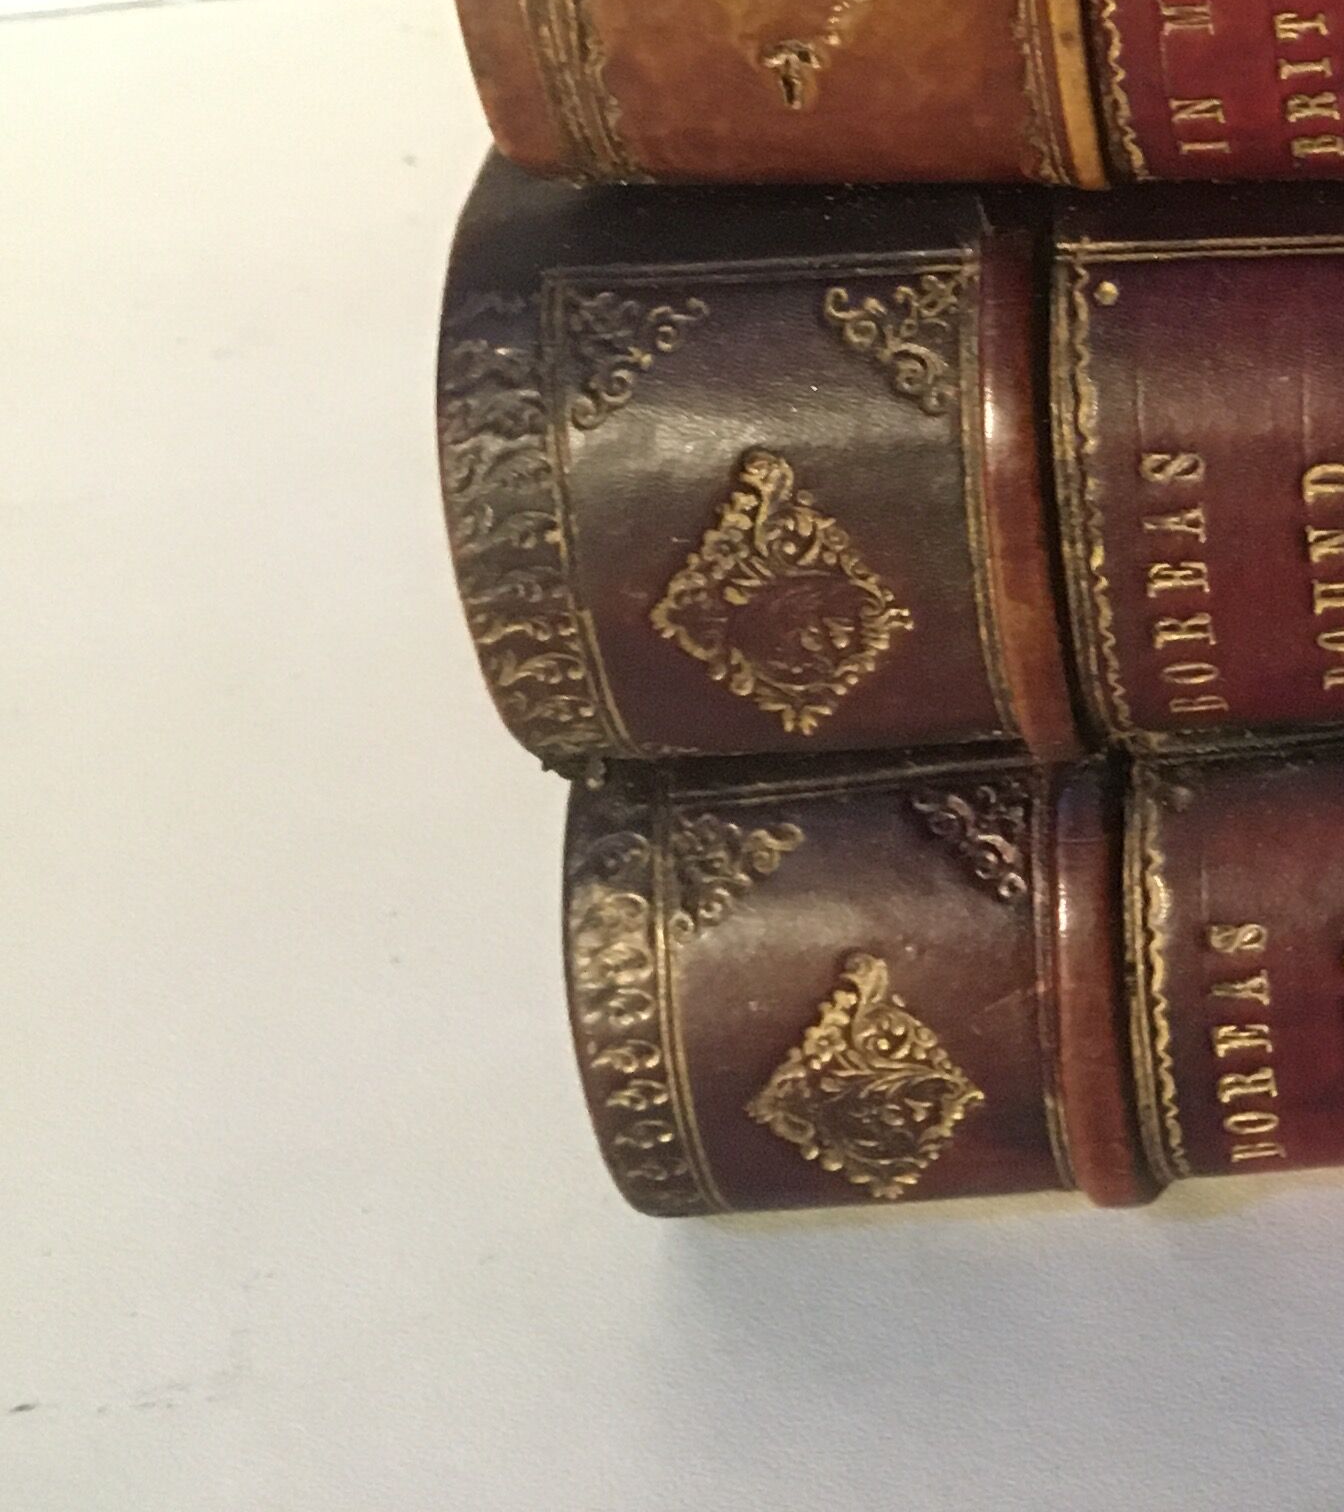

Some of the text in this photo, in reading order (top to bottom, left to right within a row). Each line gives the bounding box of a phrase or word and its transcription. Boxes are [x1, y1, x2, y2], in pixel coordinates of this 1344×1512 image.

[1170, 98, 1231, 155] IN
[1141, 452, 1230, 714] BOREAS
[1209, 923, 1287, 1163] BOREAS
